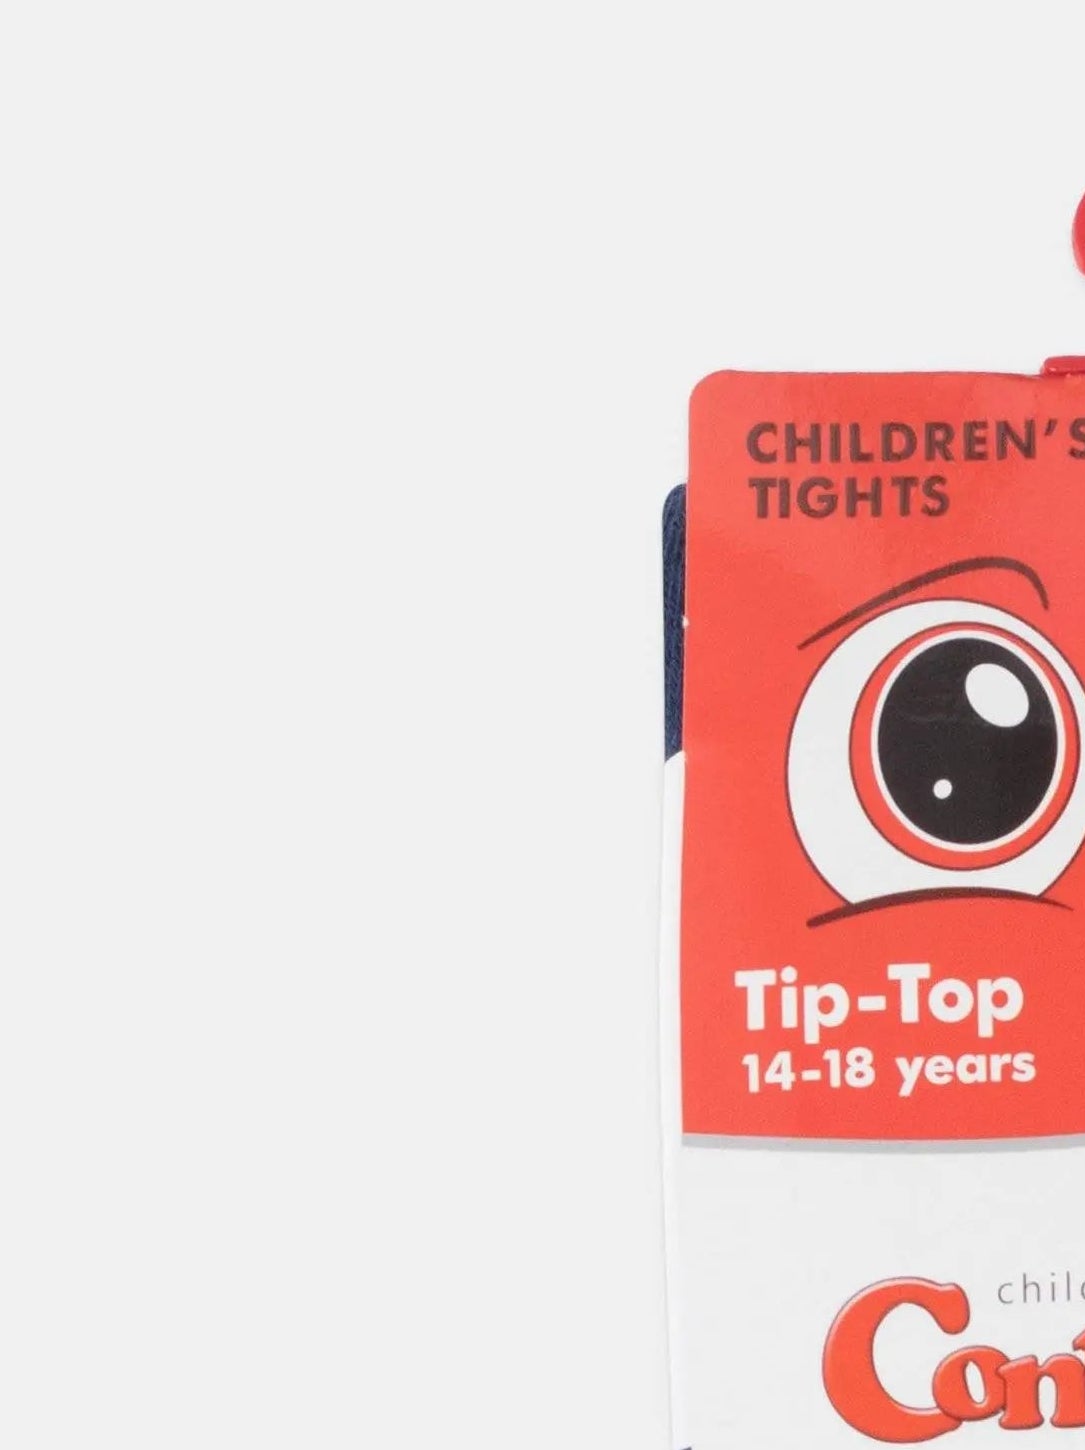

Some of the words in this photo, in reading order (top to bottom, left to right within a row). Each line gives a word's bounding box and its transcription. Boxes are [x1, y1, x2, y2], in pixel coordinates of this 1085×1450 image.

[749, 474, 950, 519] TIGHTS
[734, 963, 1024, 1043] Tip-Top
[742, 1047, 876, 1093] 14-18
[896, 1051, 1037, 1096] years
